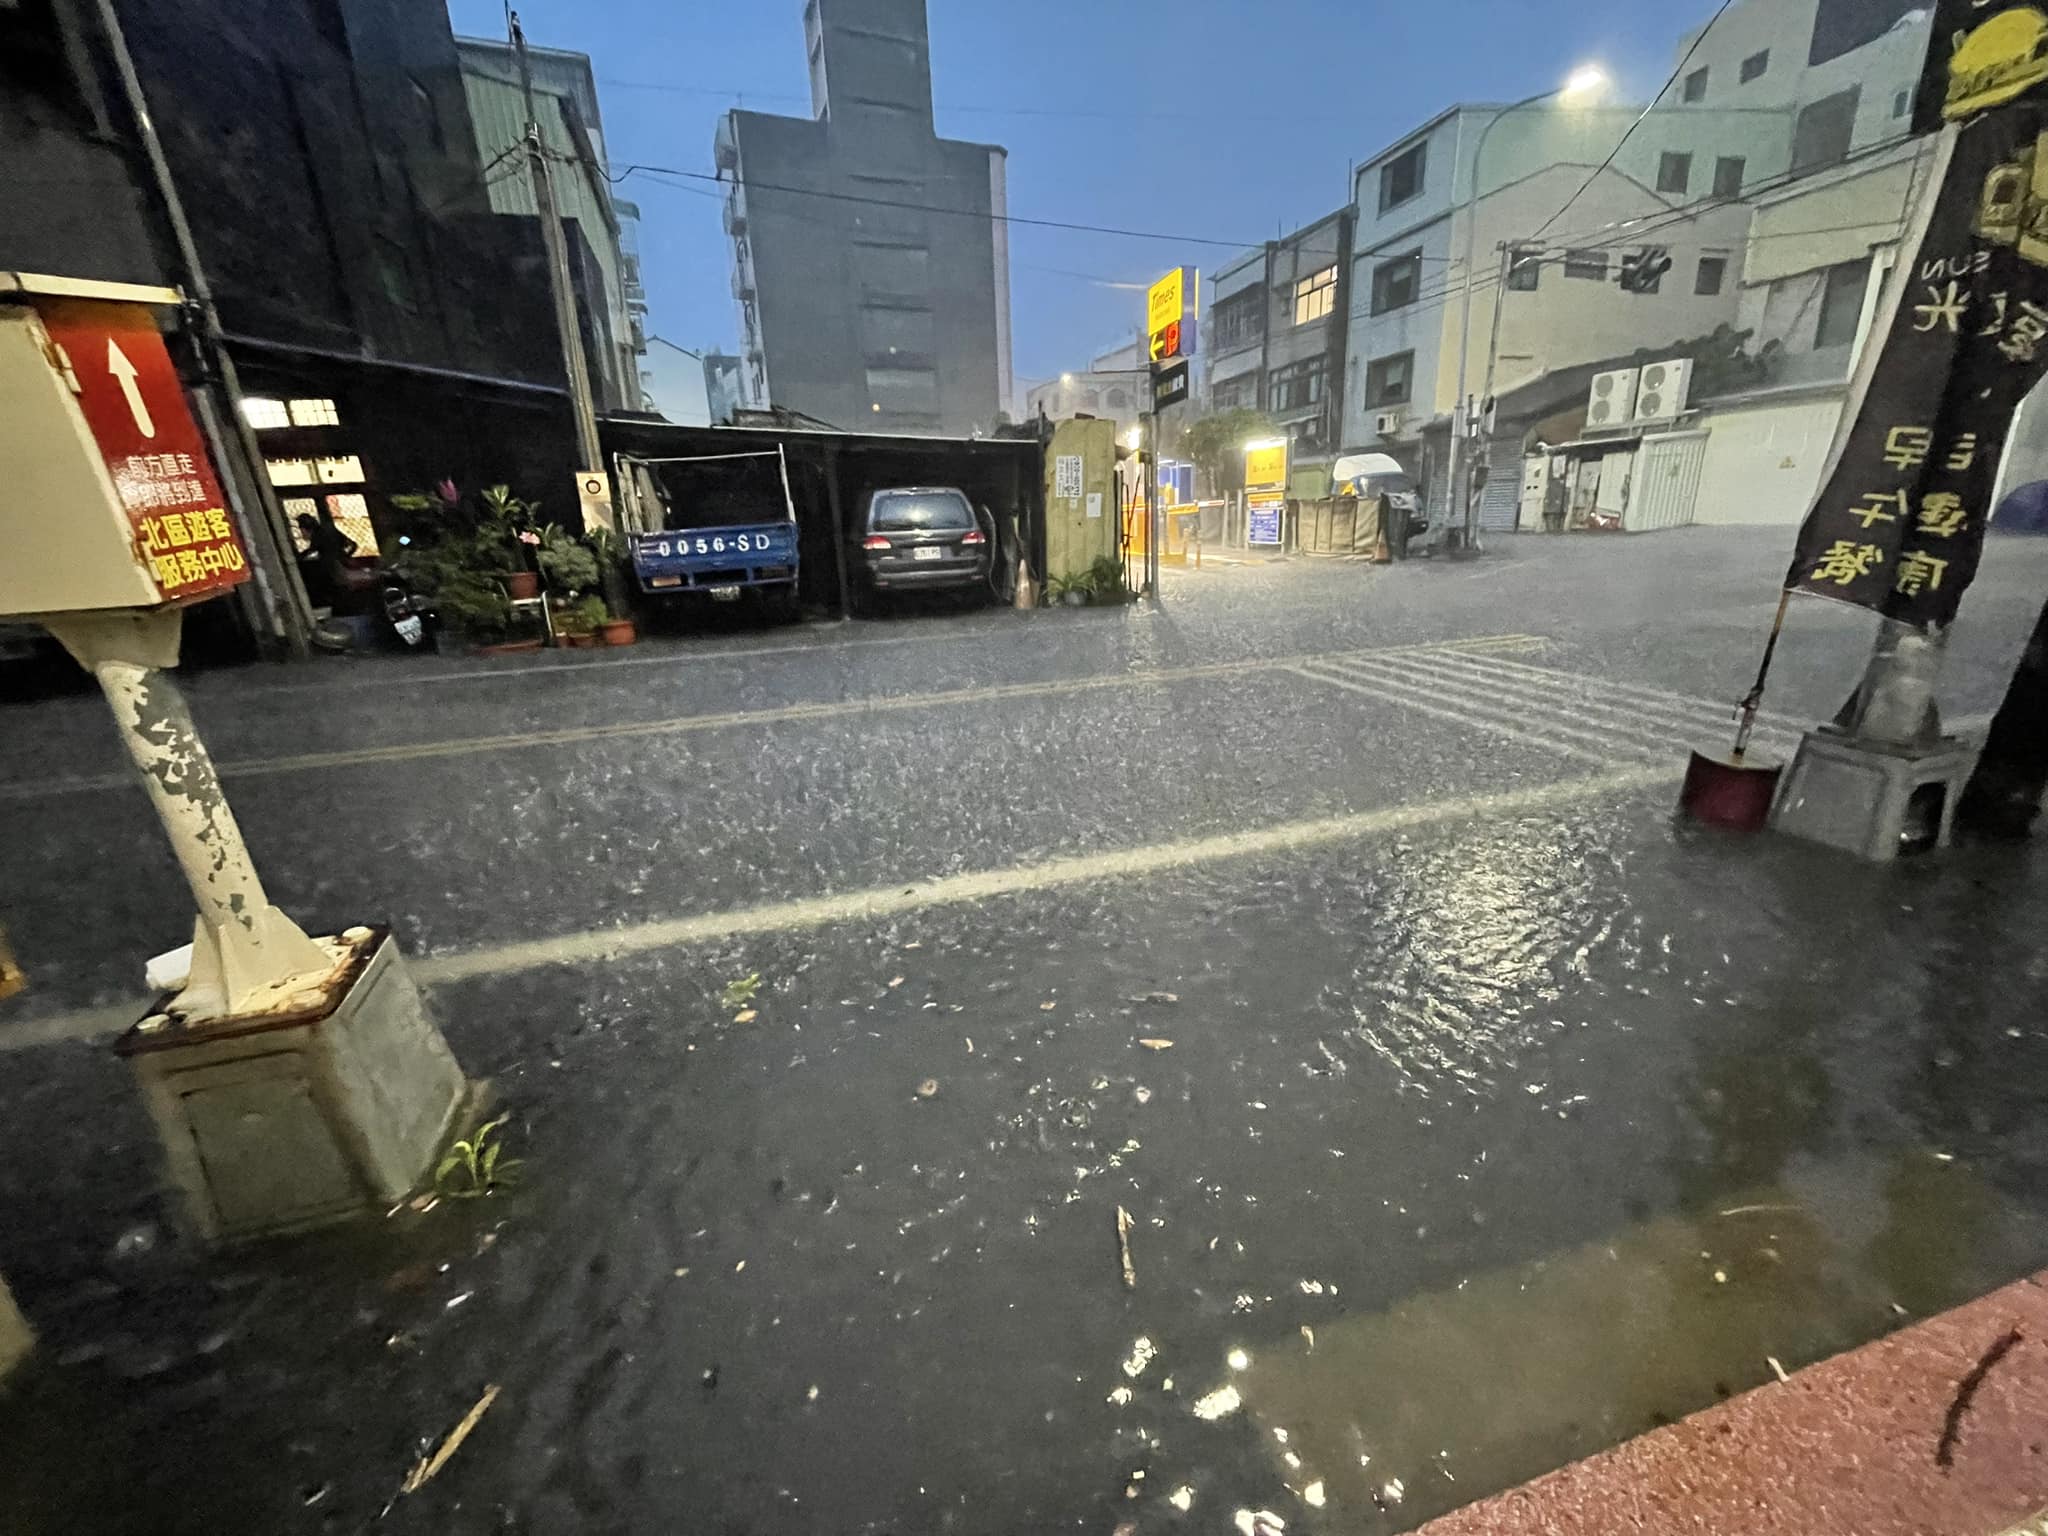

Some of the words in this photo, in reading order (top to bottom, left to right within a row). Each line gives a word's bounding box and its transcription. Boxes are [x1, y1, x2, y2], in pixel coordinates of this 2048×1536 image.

[1152, 286, 1176, 313] Times
[126, 453, 197, 478] 前方直走
[139, 508, 231, 550] 北區遊客
[659, 534, 770, 557] 0056-SD
[155, 542, 245, 590] 服務中心
